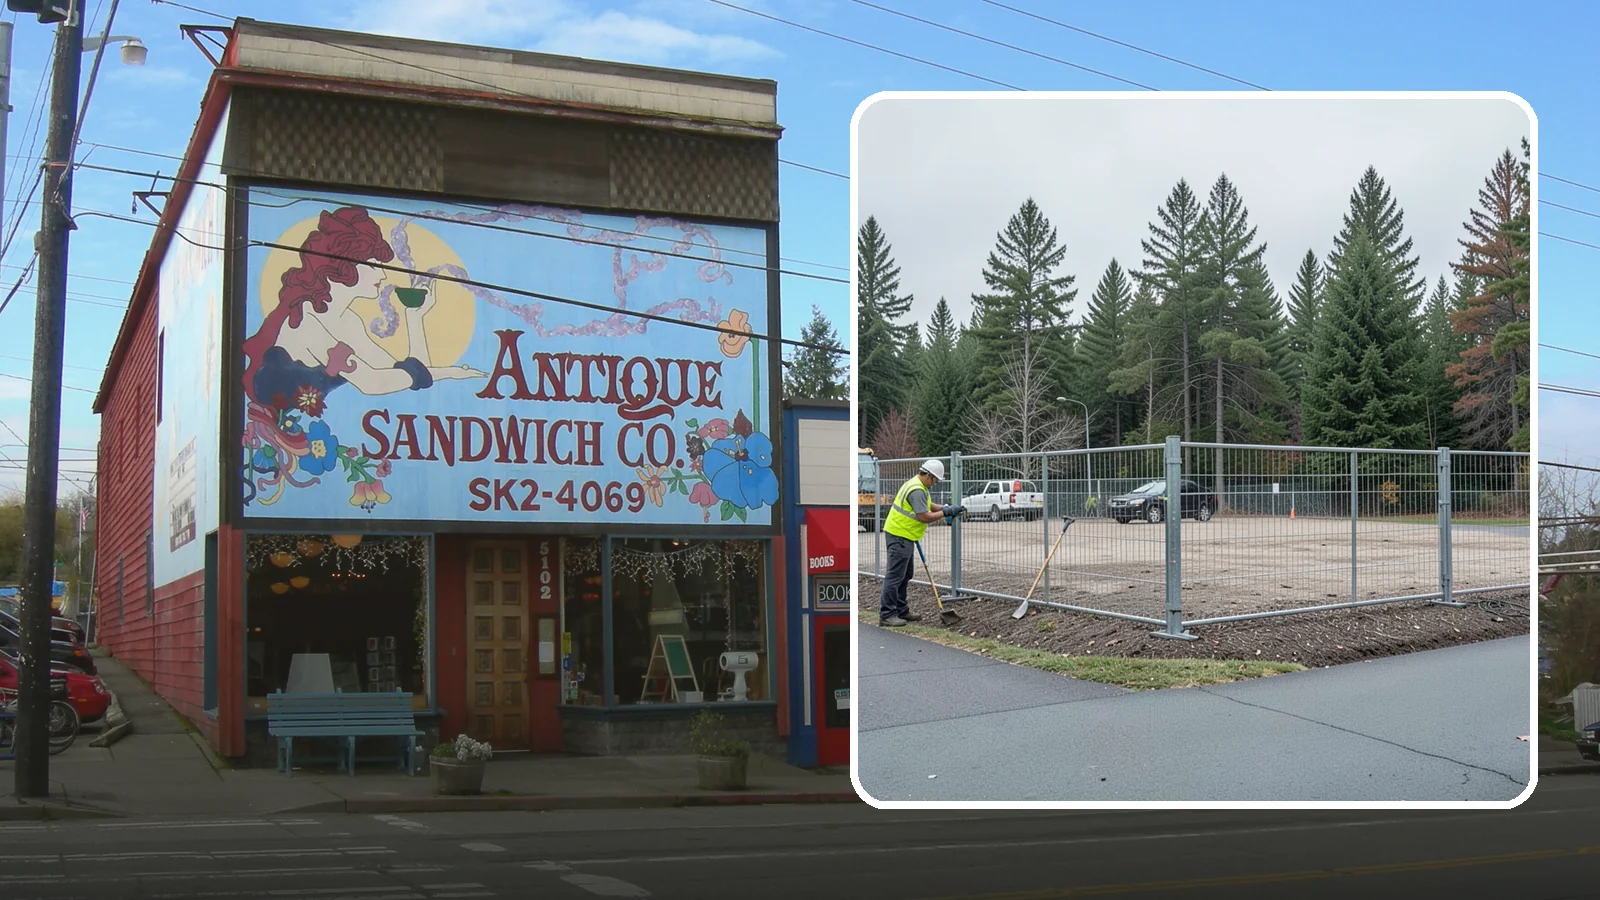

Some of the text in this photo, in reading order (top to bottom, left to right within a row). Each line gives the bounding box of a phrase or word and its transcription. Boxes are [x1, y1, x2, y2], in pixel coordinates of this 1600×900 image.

[476, 329, 724, 421] ANTIQUE
[361, 409, 686, 470] SANDWICH CO.
[468, 477, 647, 513] SK2-4069
[540, 541, 552, 599] 5102
[809, 555, 835, 569] BOOKS
